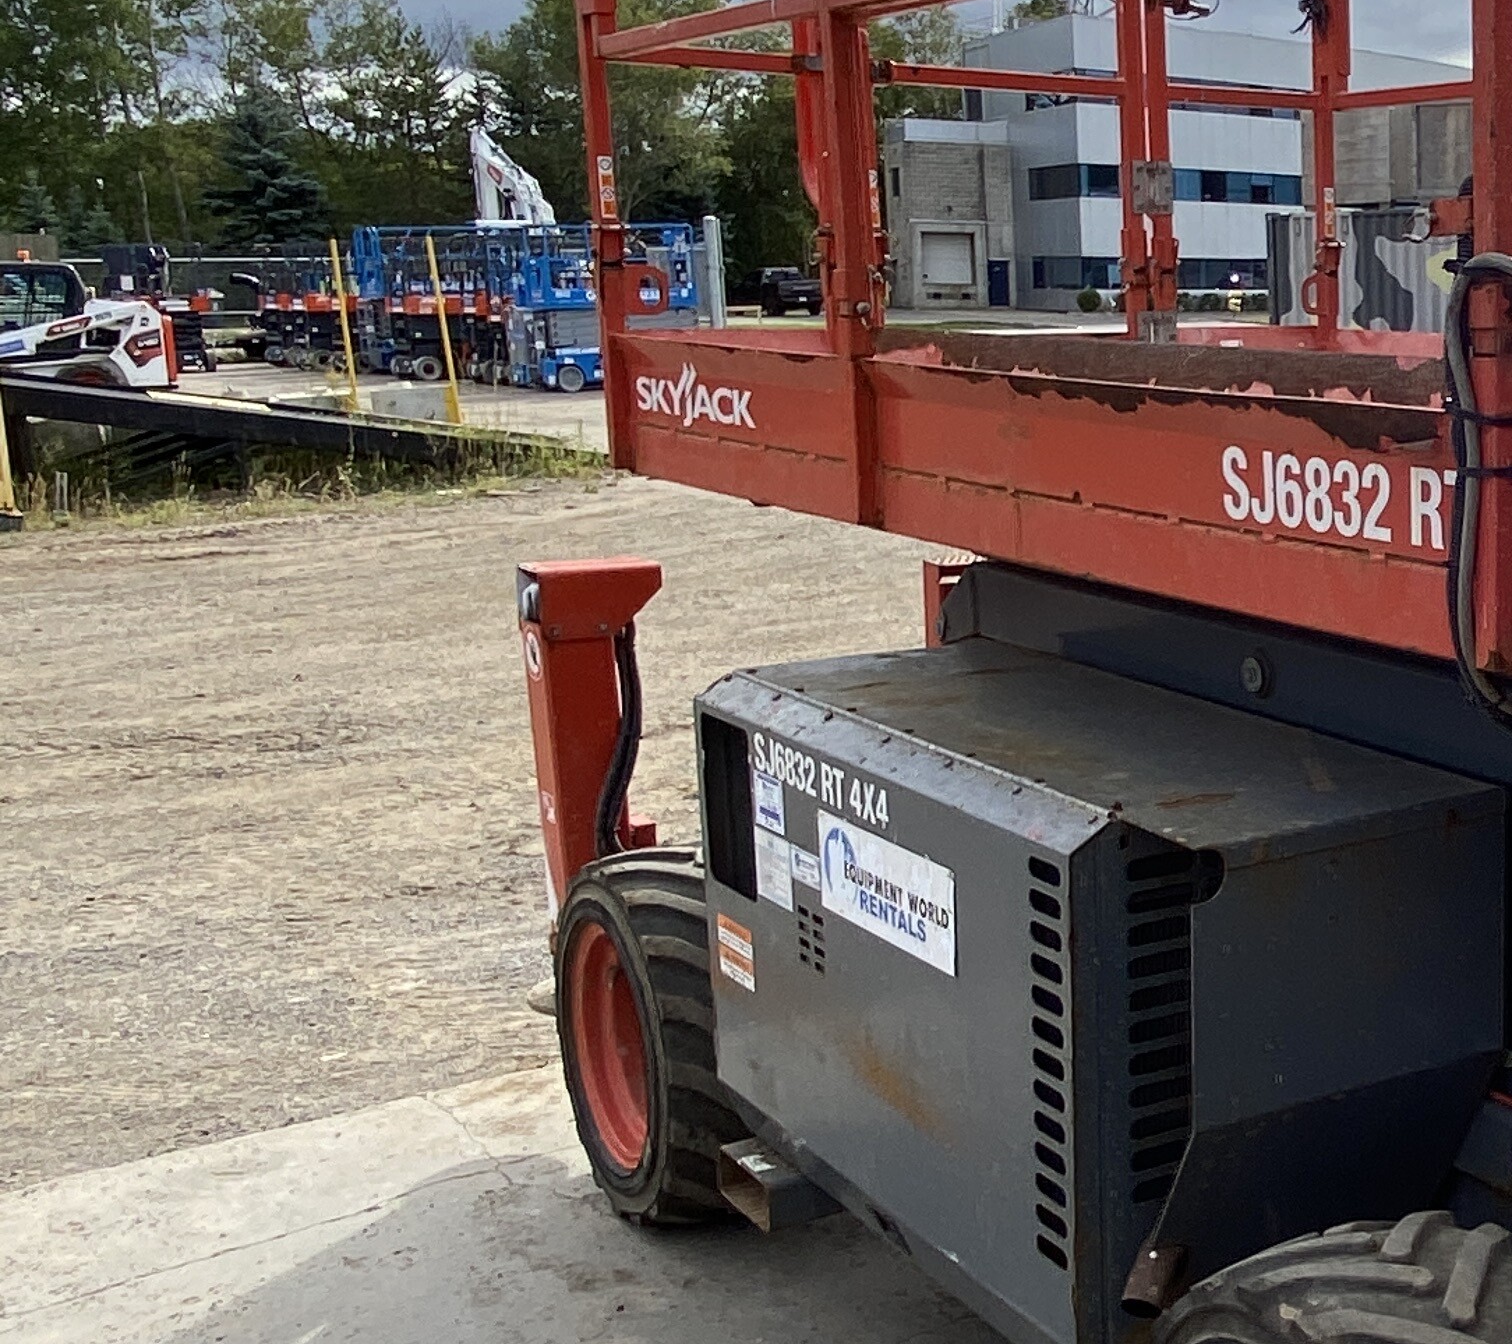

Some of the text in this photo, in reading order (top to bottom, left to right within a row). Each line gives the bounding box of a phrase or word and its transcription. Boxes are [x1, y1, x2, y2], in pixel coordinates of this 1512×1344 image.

[636, 362, 757, 429] SKYJACK
[1222, 445, 1457, 550] SJ6832 R
[753, 732, 817, 797] SJ6832
[820, 761, 845, 810] RT
[849, 778, 889, 830] 4X4
[844, 859, 903, 907] EQUIPMENT
[907, 891, 949, 929] WORLD
[859, 889, 926, 942] RENTALS
